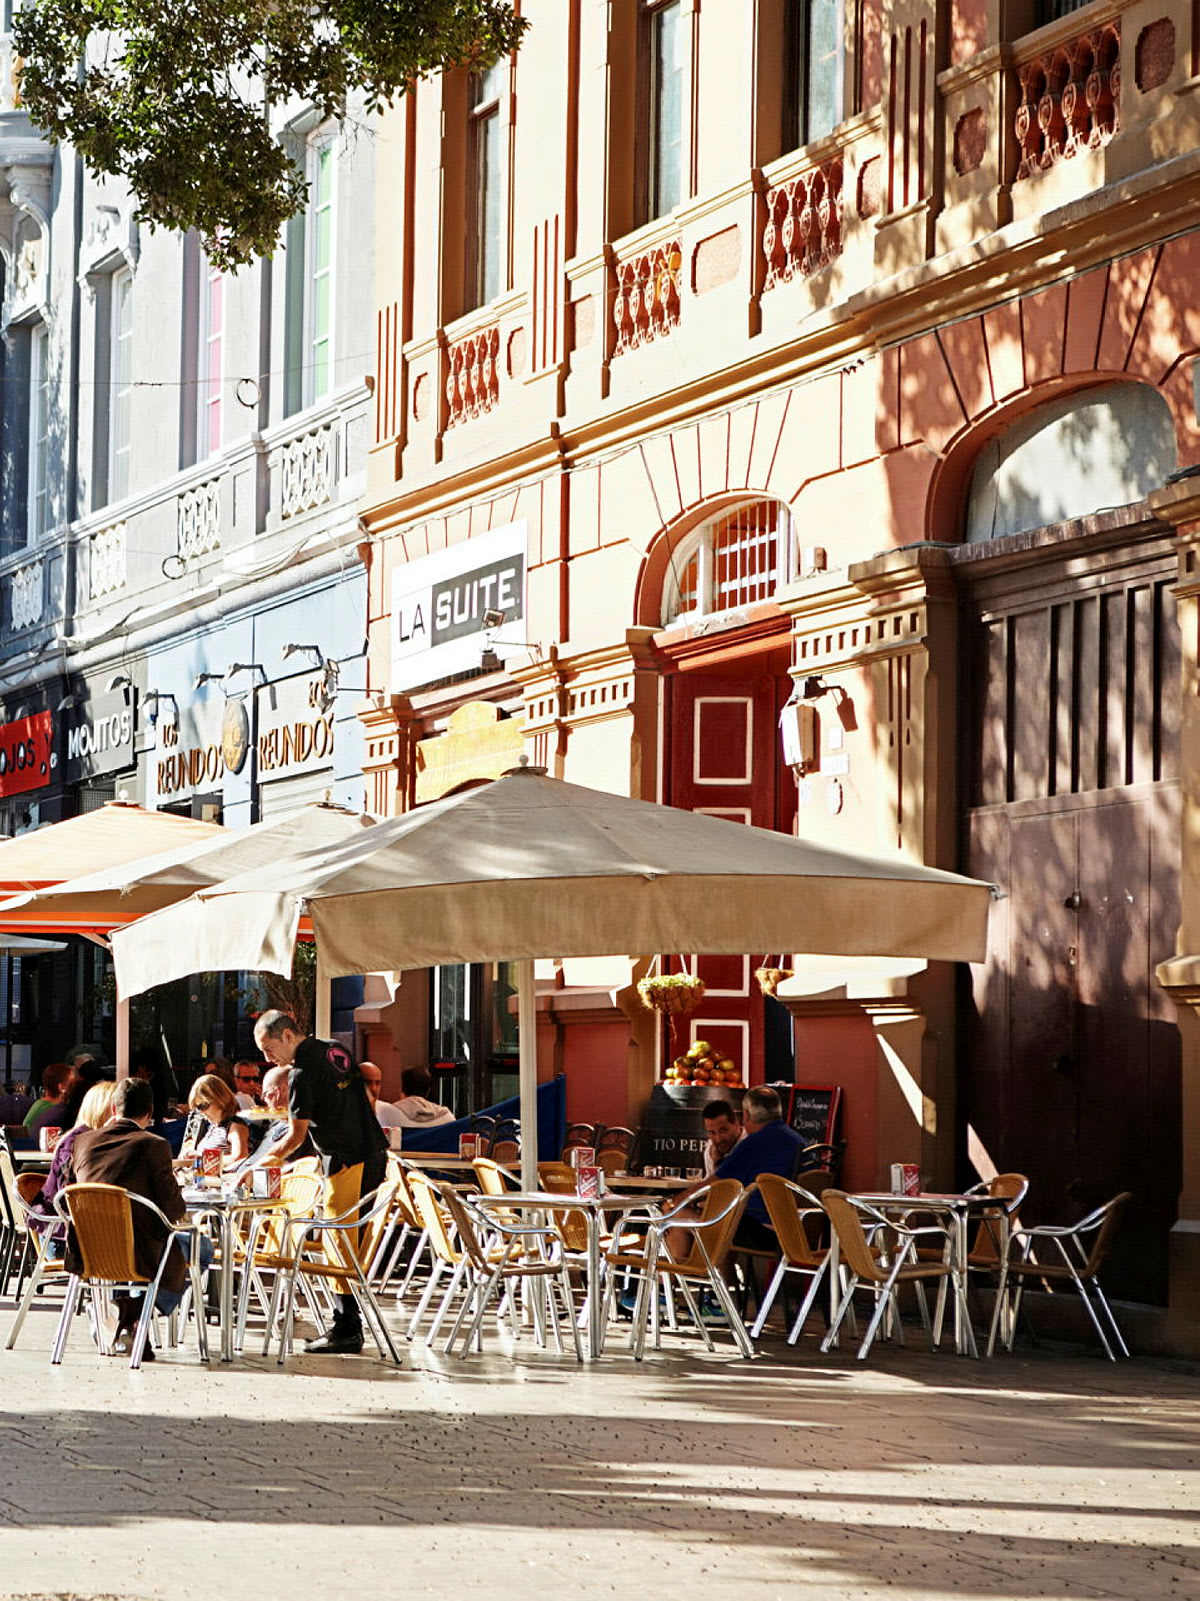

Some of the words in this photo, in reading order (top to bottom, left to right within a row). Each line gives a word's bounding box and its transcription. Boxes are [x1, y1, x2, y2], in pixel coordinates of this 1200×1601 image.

[399, 603, 426, 643] LA
[435, 568, 516, 631] SUITE
[68, 710, 131, 760] MOJITOS
[259, 713, 335, 771] REUNIDOS
[157, 744, 224, 795] REUNIDOS
[654, 1138, 676, 1151] TIO
